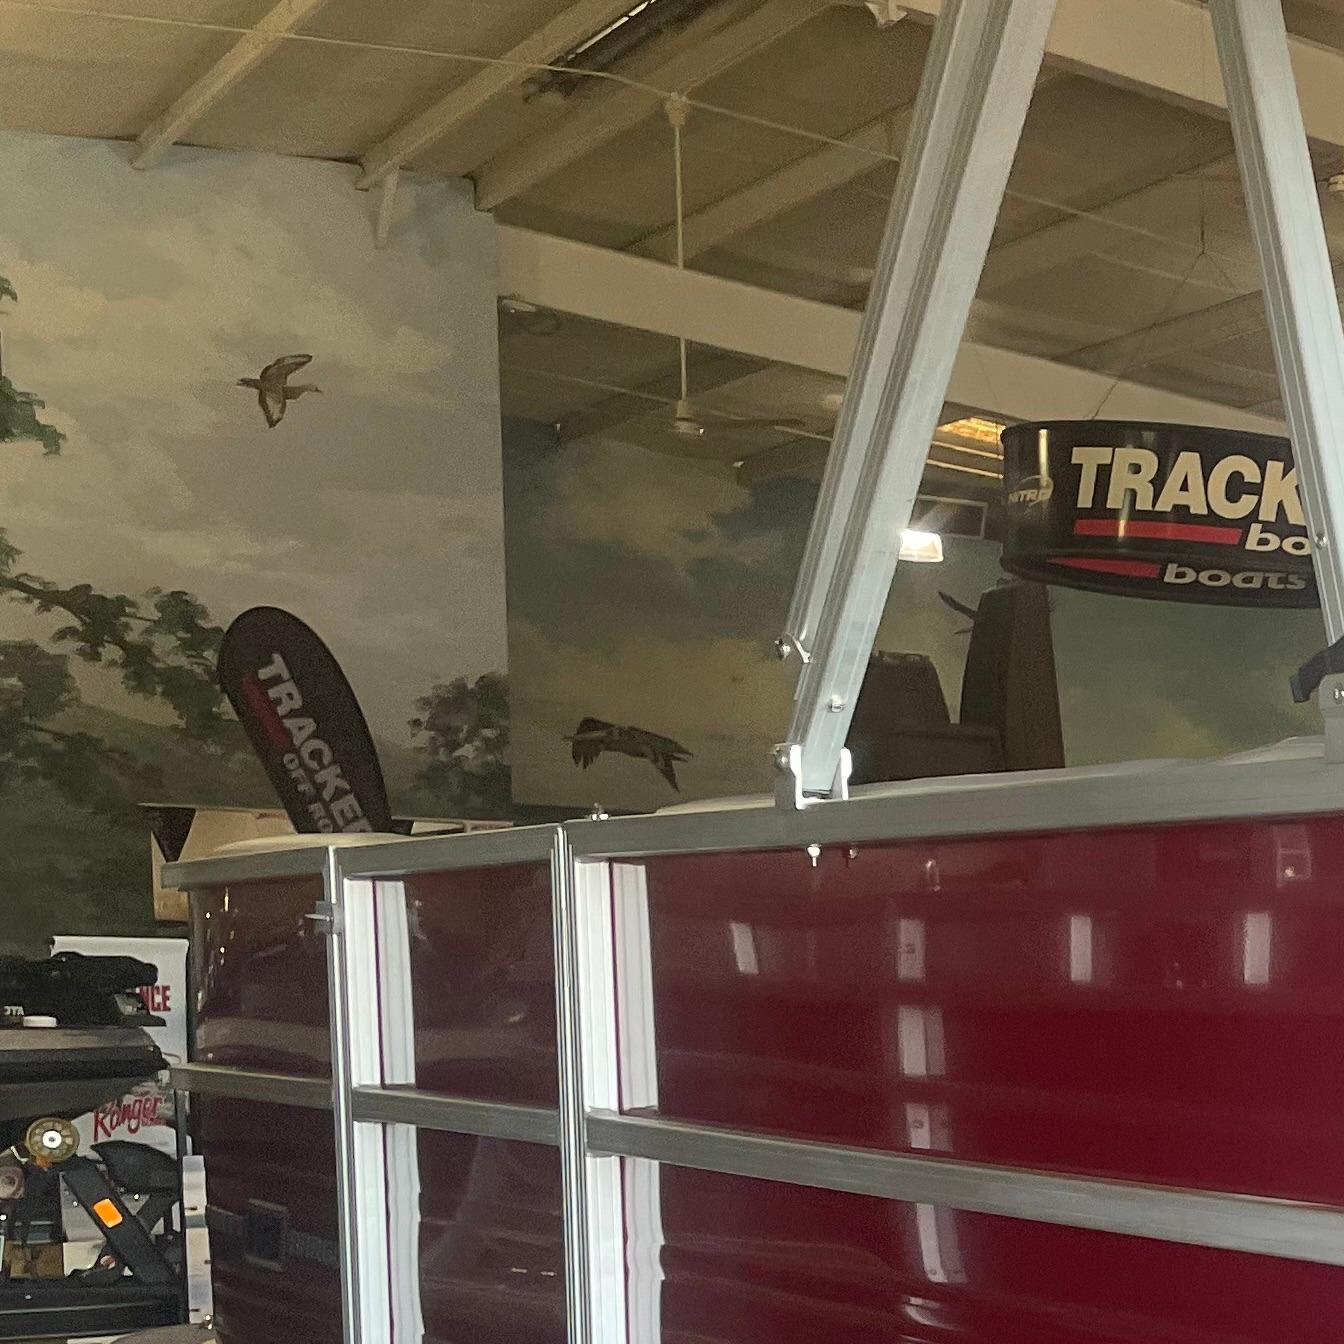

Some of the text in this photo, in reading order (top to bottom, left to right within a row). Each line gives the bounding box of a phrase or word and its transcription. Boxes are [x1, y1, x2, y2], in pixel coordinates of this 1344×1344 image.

[1071, 447, 1305, 526] TRACK
[1163, 562, 1307, 590] boats
[308, 801, 334, 833] RO
